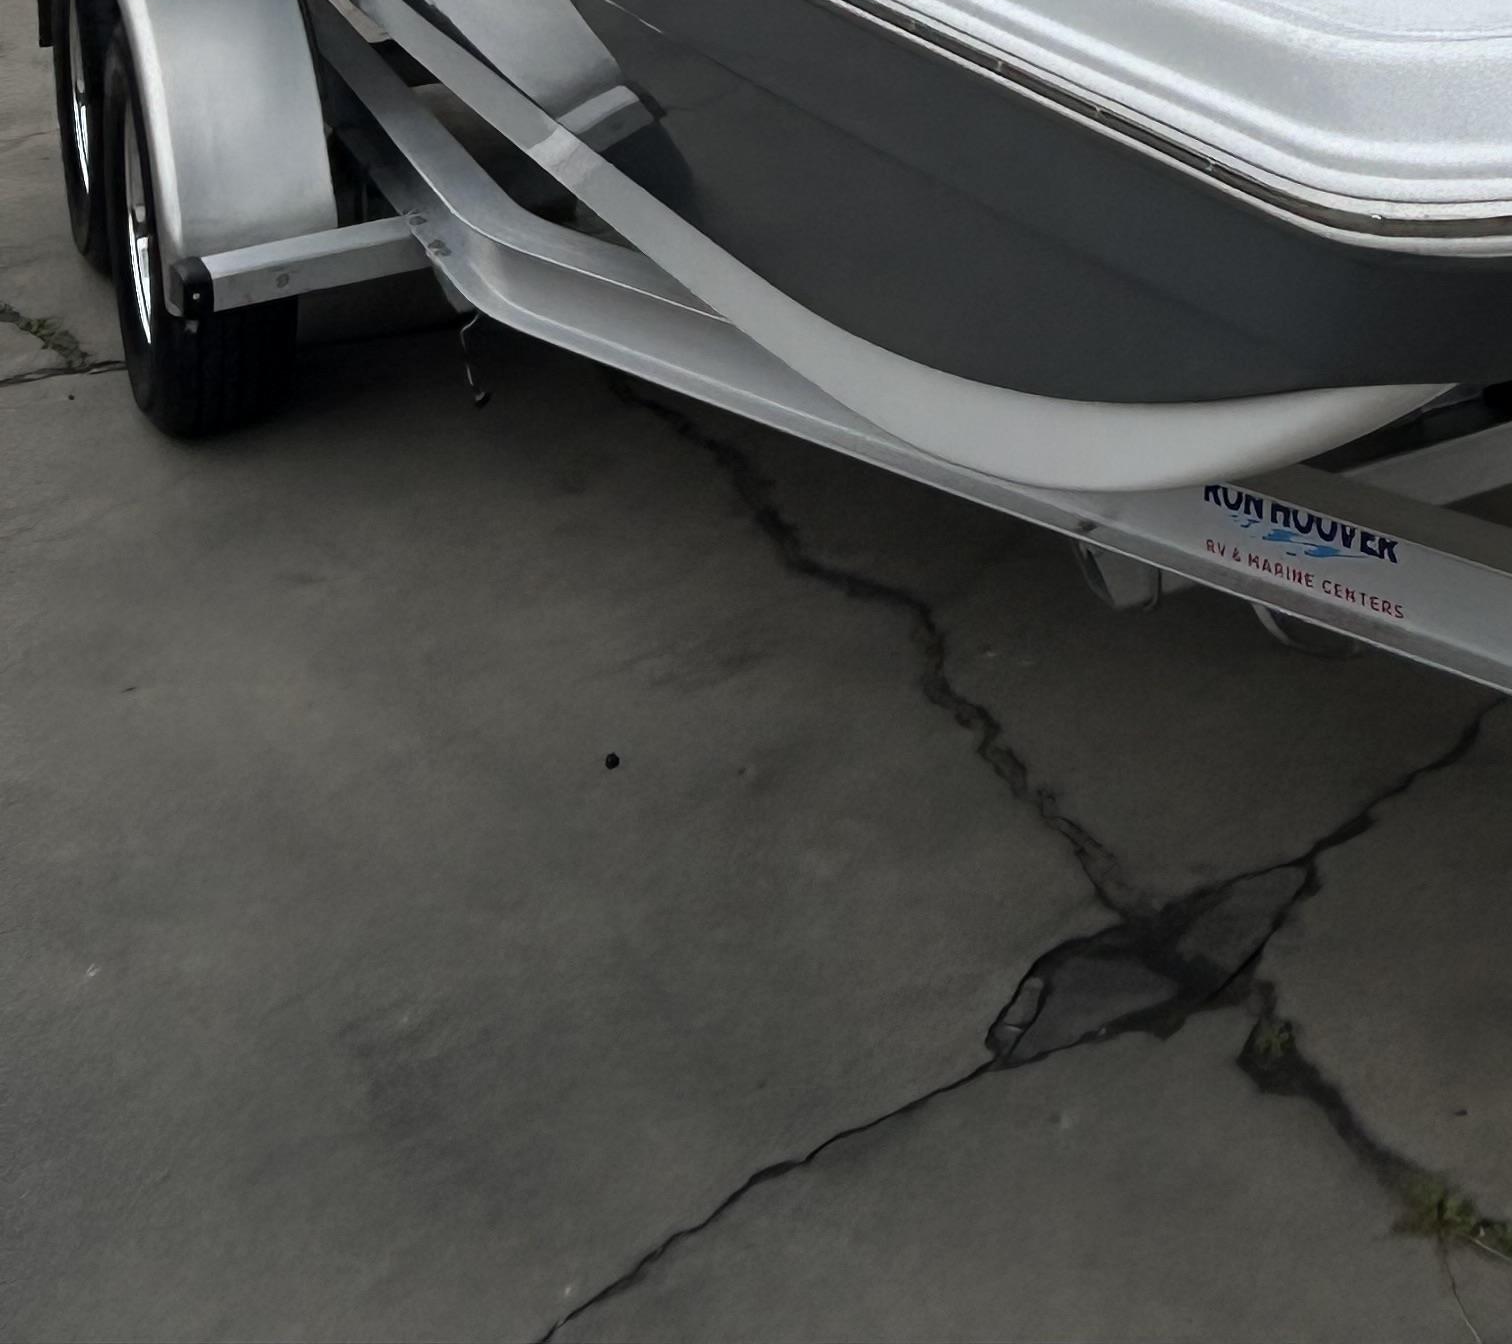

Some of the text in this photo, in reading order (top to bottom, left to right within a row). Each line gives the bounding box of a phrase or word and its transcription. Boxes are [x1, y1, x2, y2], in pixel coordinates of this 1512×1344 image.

[1206, 538, 1405, 620] RV & MARINE CENTERS
